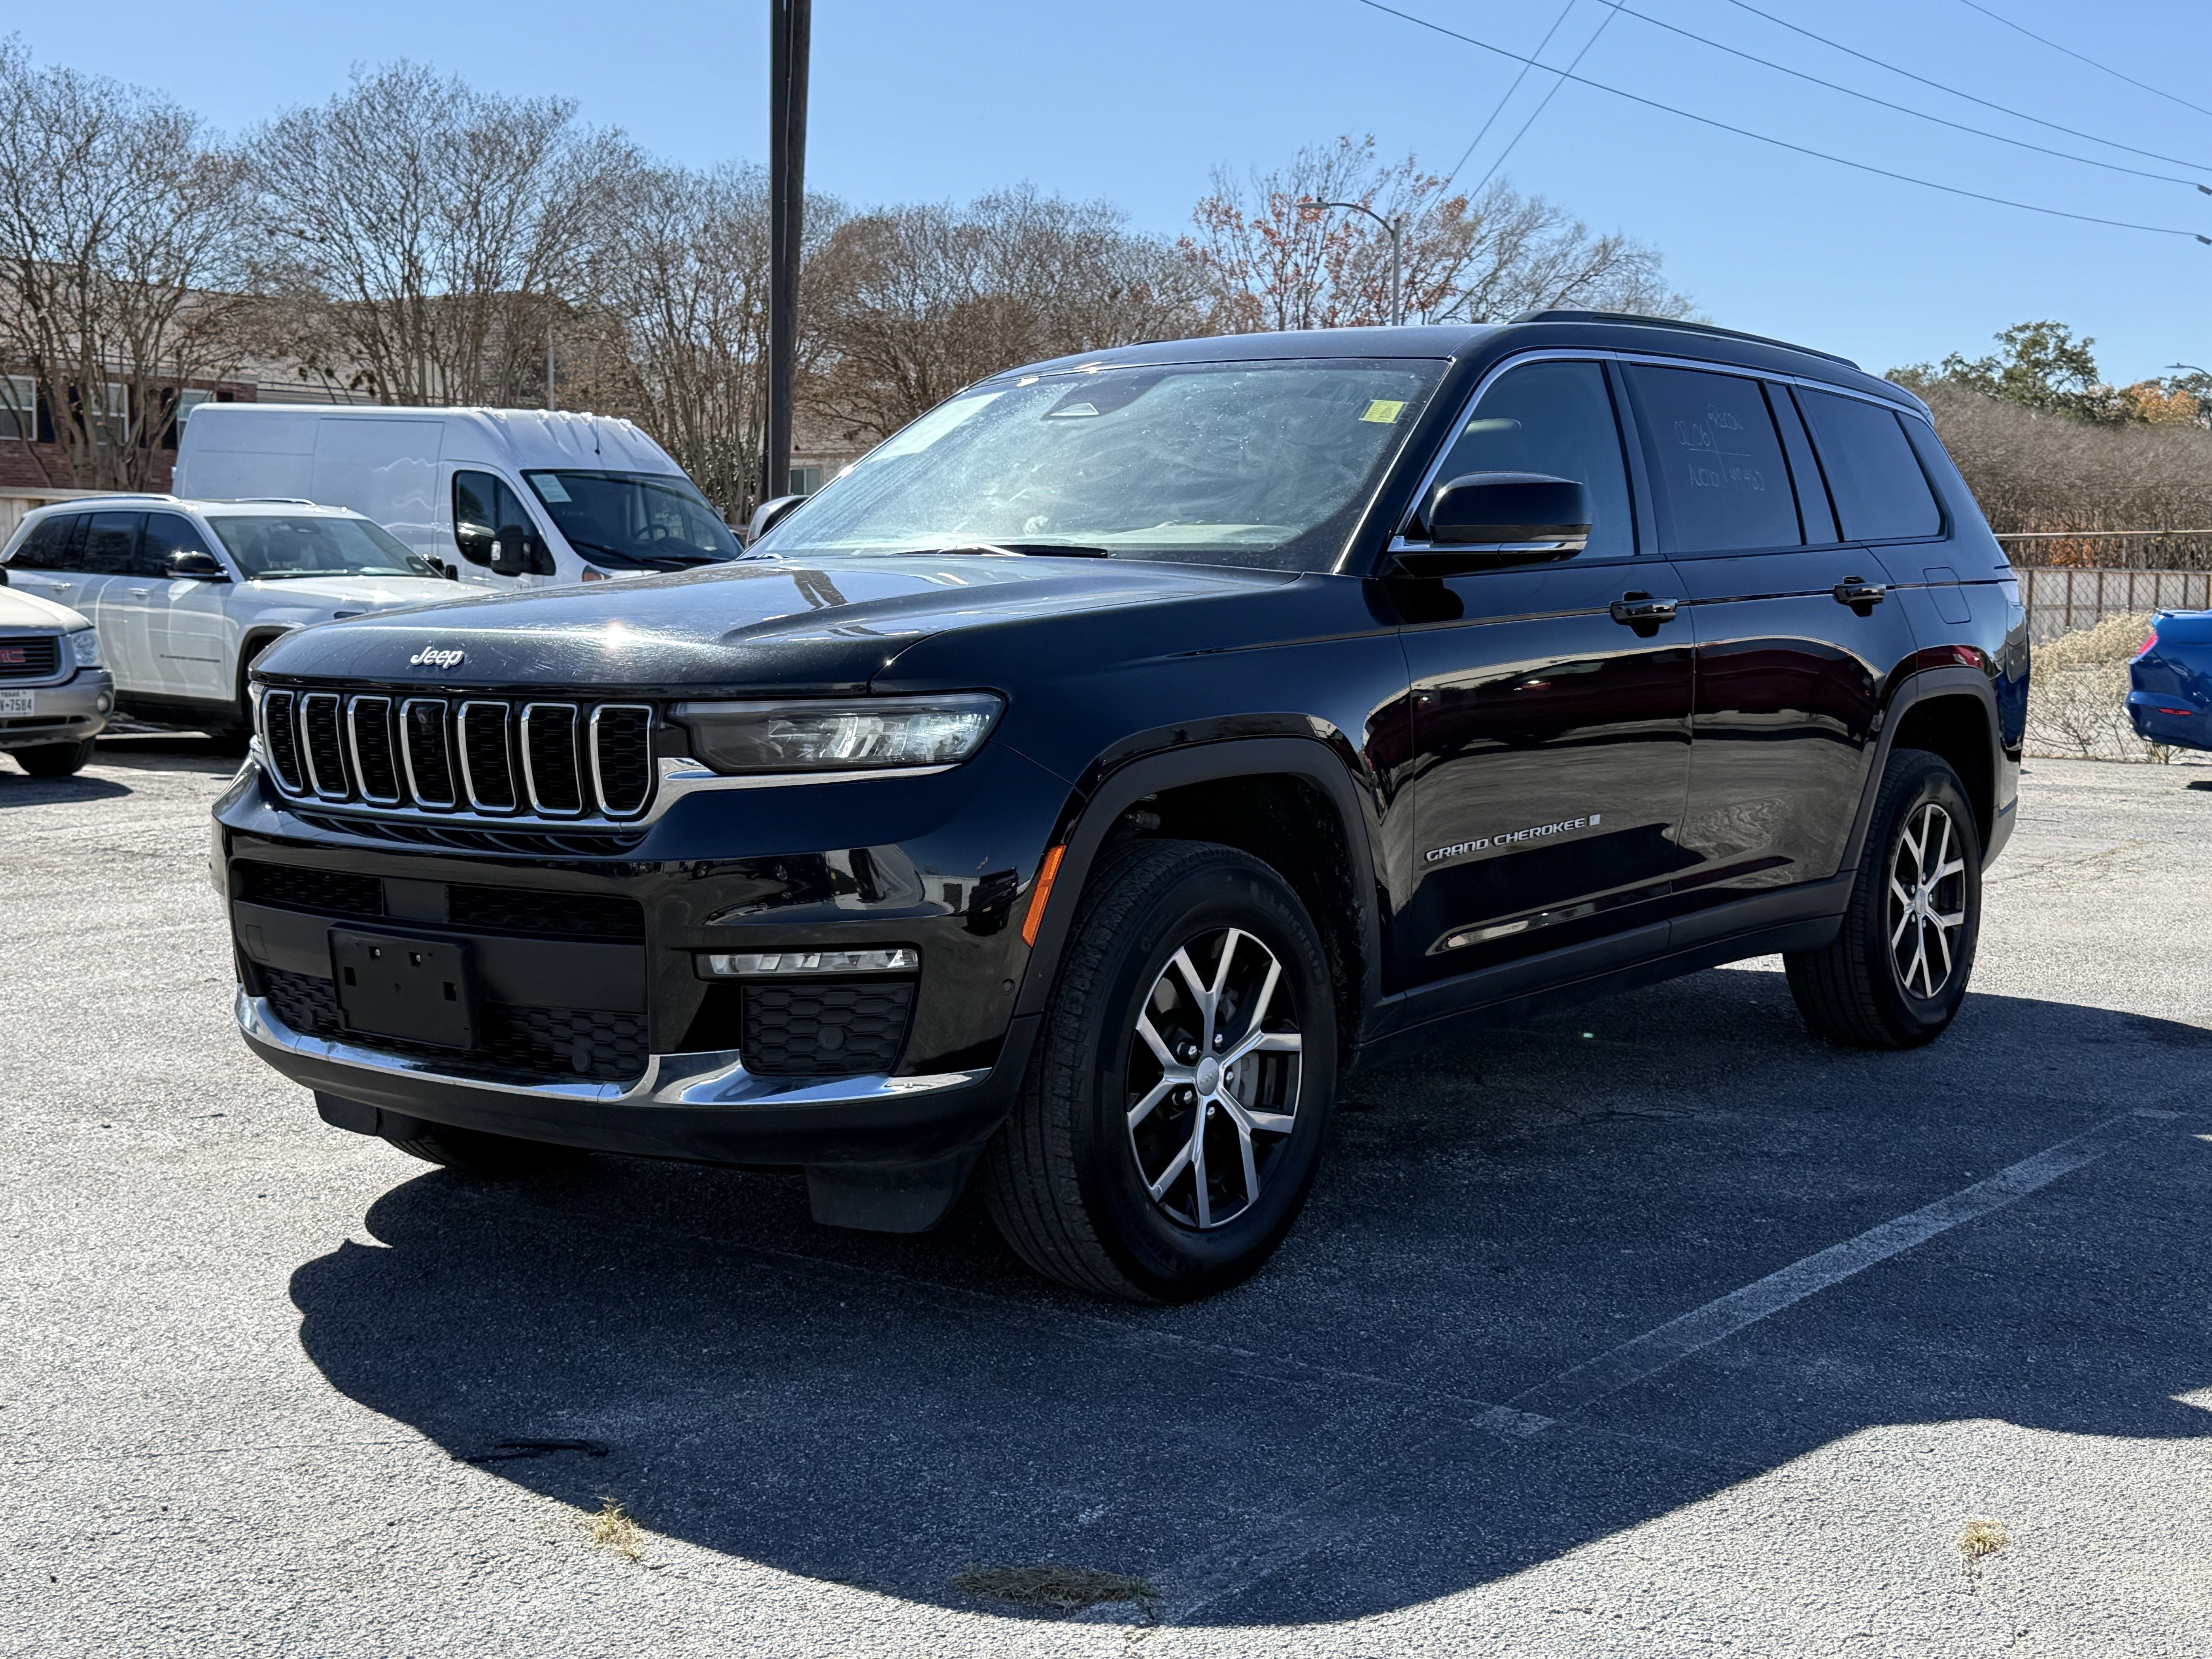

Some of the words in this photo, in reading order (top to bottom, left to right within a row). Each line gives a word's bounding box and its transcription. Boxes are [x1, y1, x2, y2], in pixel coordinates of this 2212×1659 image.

[410, 646, 464, 669] Jeep
[1426, 838, 1489, 862] GRAND
[1493, 817, 1586, 846] CHEROKEE
